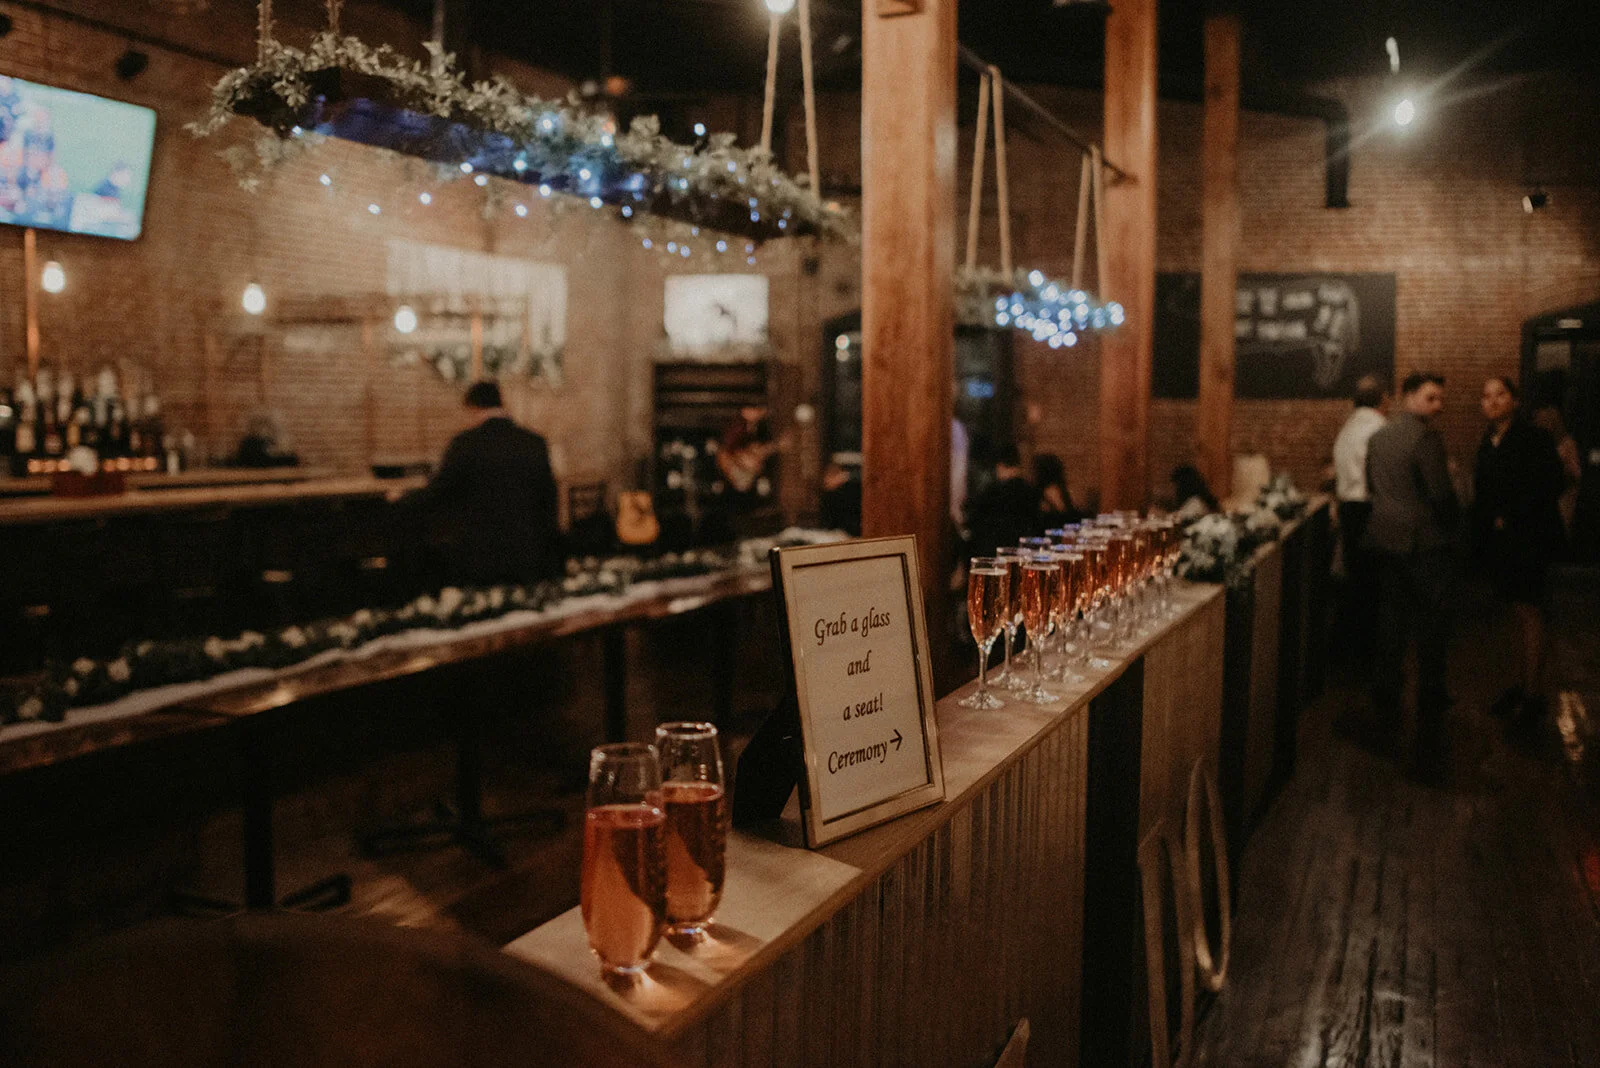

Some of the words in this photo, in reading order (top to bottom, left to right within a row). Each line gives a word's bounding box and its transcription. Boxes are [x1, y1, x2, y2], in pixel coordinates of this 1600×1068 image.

[814, 612, 847, 646] Grab
[851, 617, 859, 633] a
[862, 607, 891, 637] glass
[847, 650, 872, 676] and
[843, 705, 851, 721] a
[855, 692, 883, 718] seat!
[828, 741, 888, 775] Ceremony
